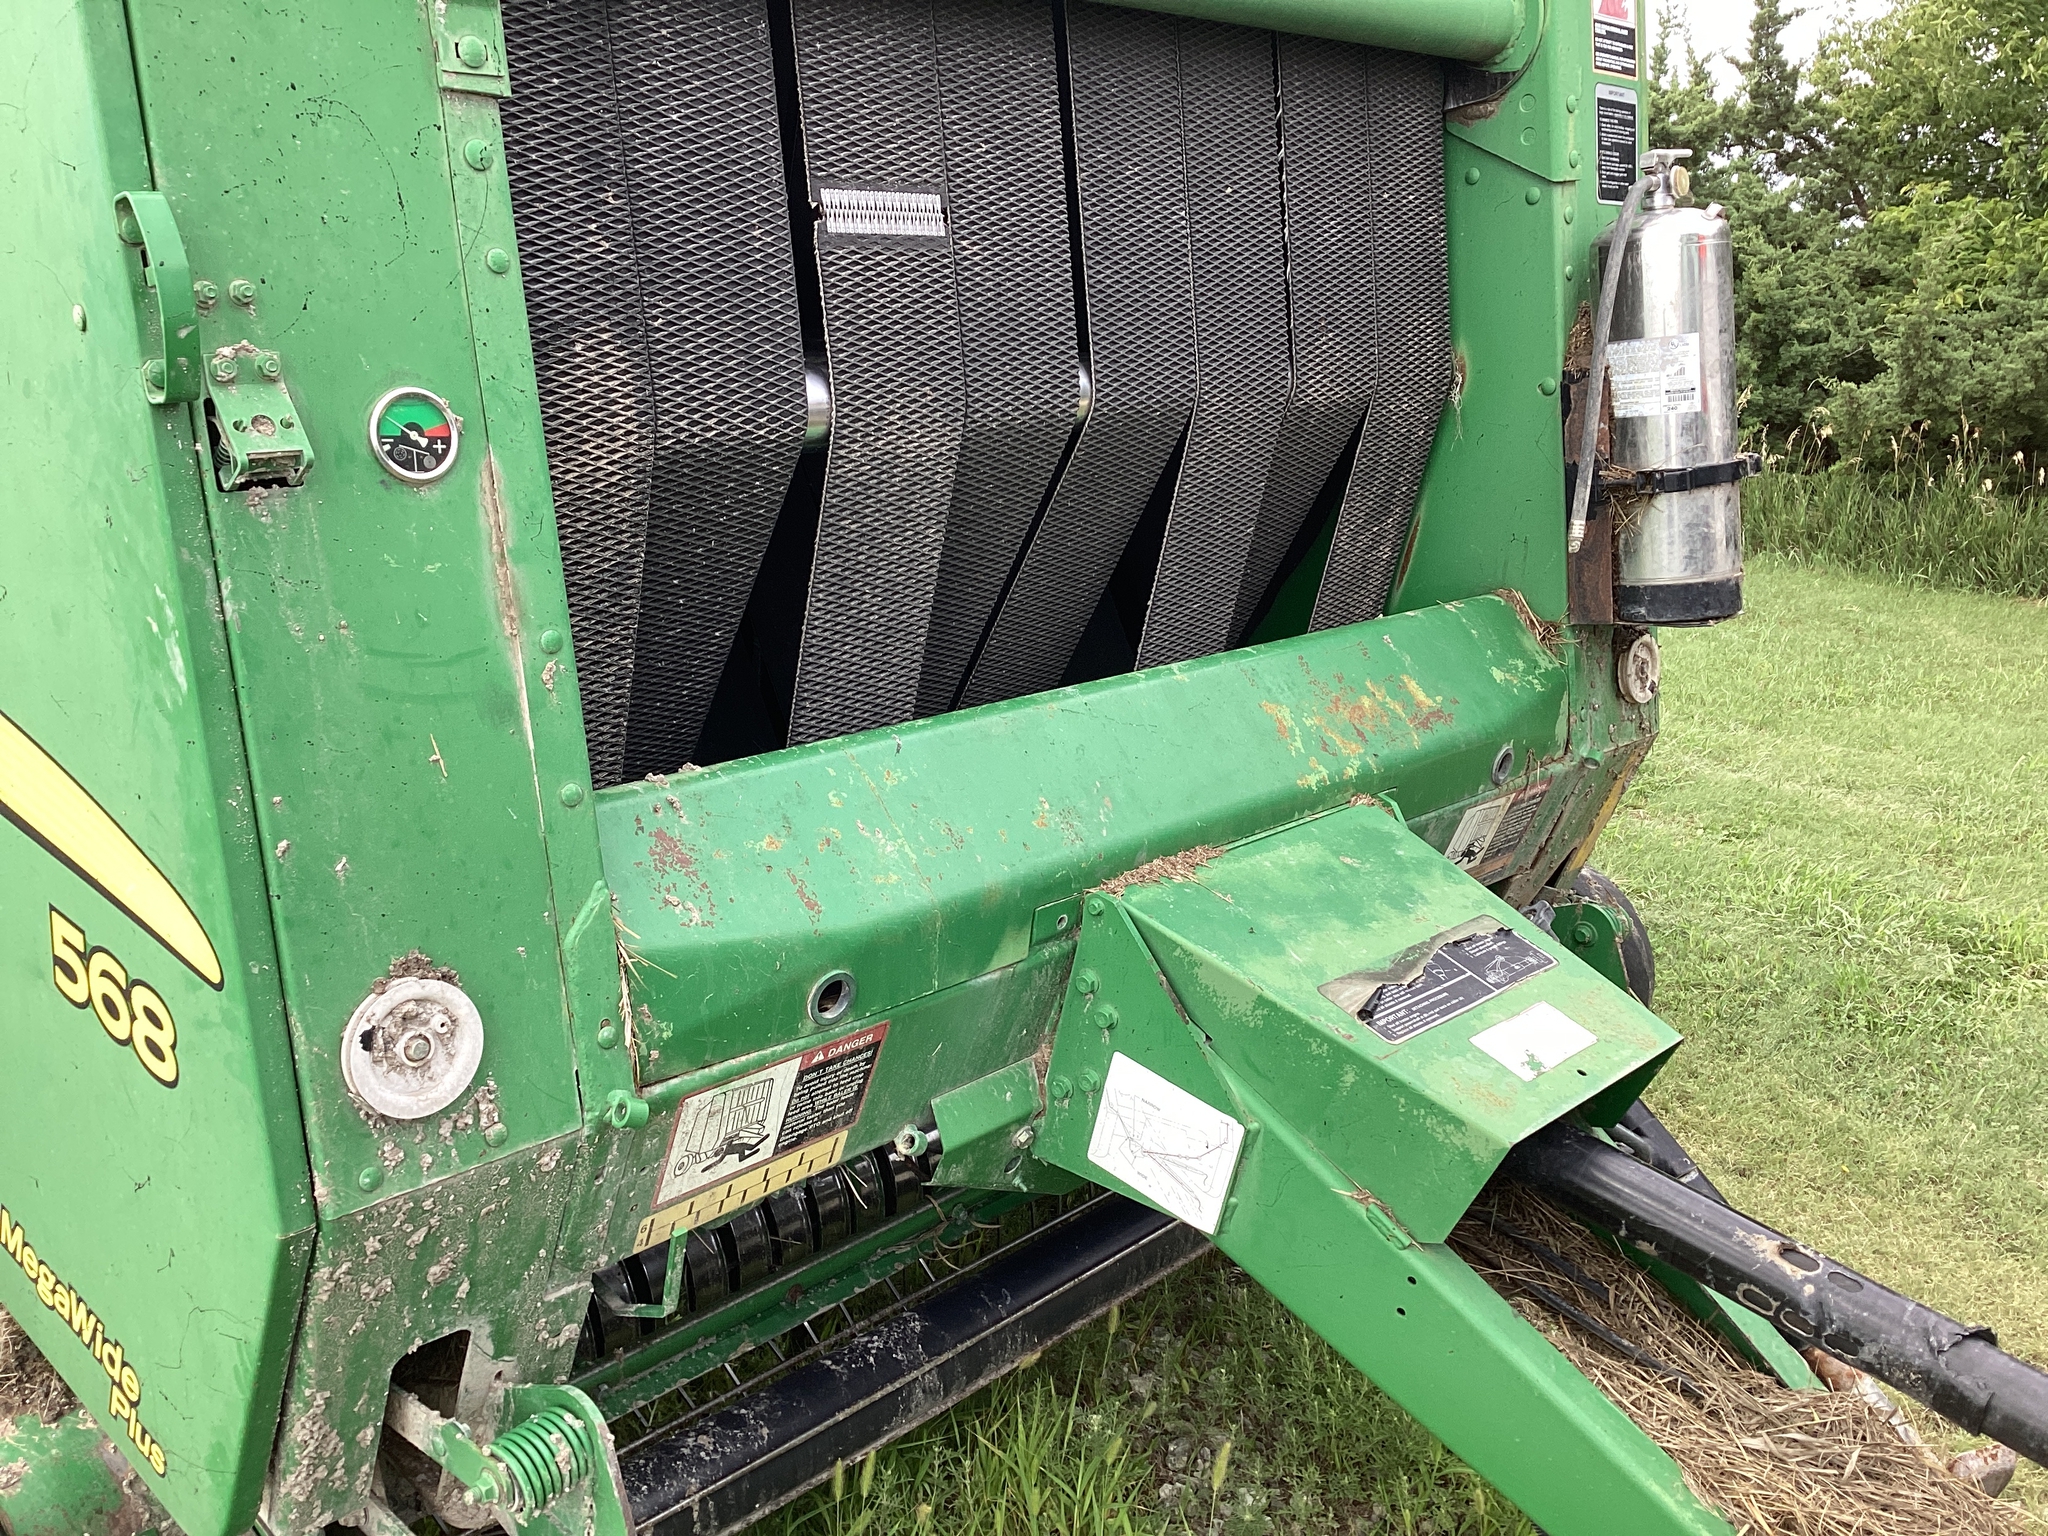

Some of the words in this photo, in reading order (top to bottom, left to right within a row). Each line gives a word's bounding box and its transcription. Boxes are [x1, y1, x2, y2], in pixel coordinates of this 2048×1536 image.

[49, 903, 179, 1089] 568
[825, 1062, 841, 1073] TAKE
[827, 1034, 874, 1057] DANGER
[0, 1204, 141, 1403] MegaWide
[109, 1384, 167, 1478] Plus
